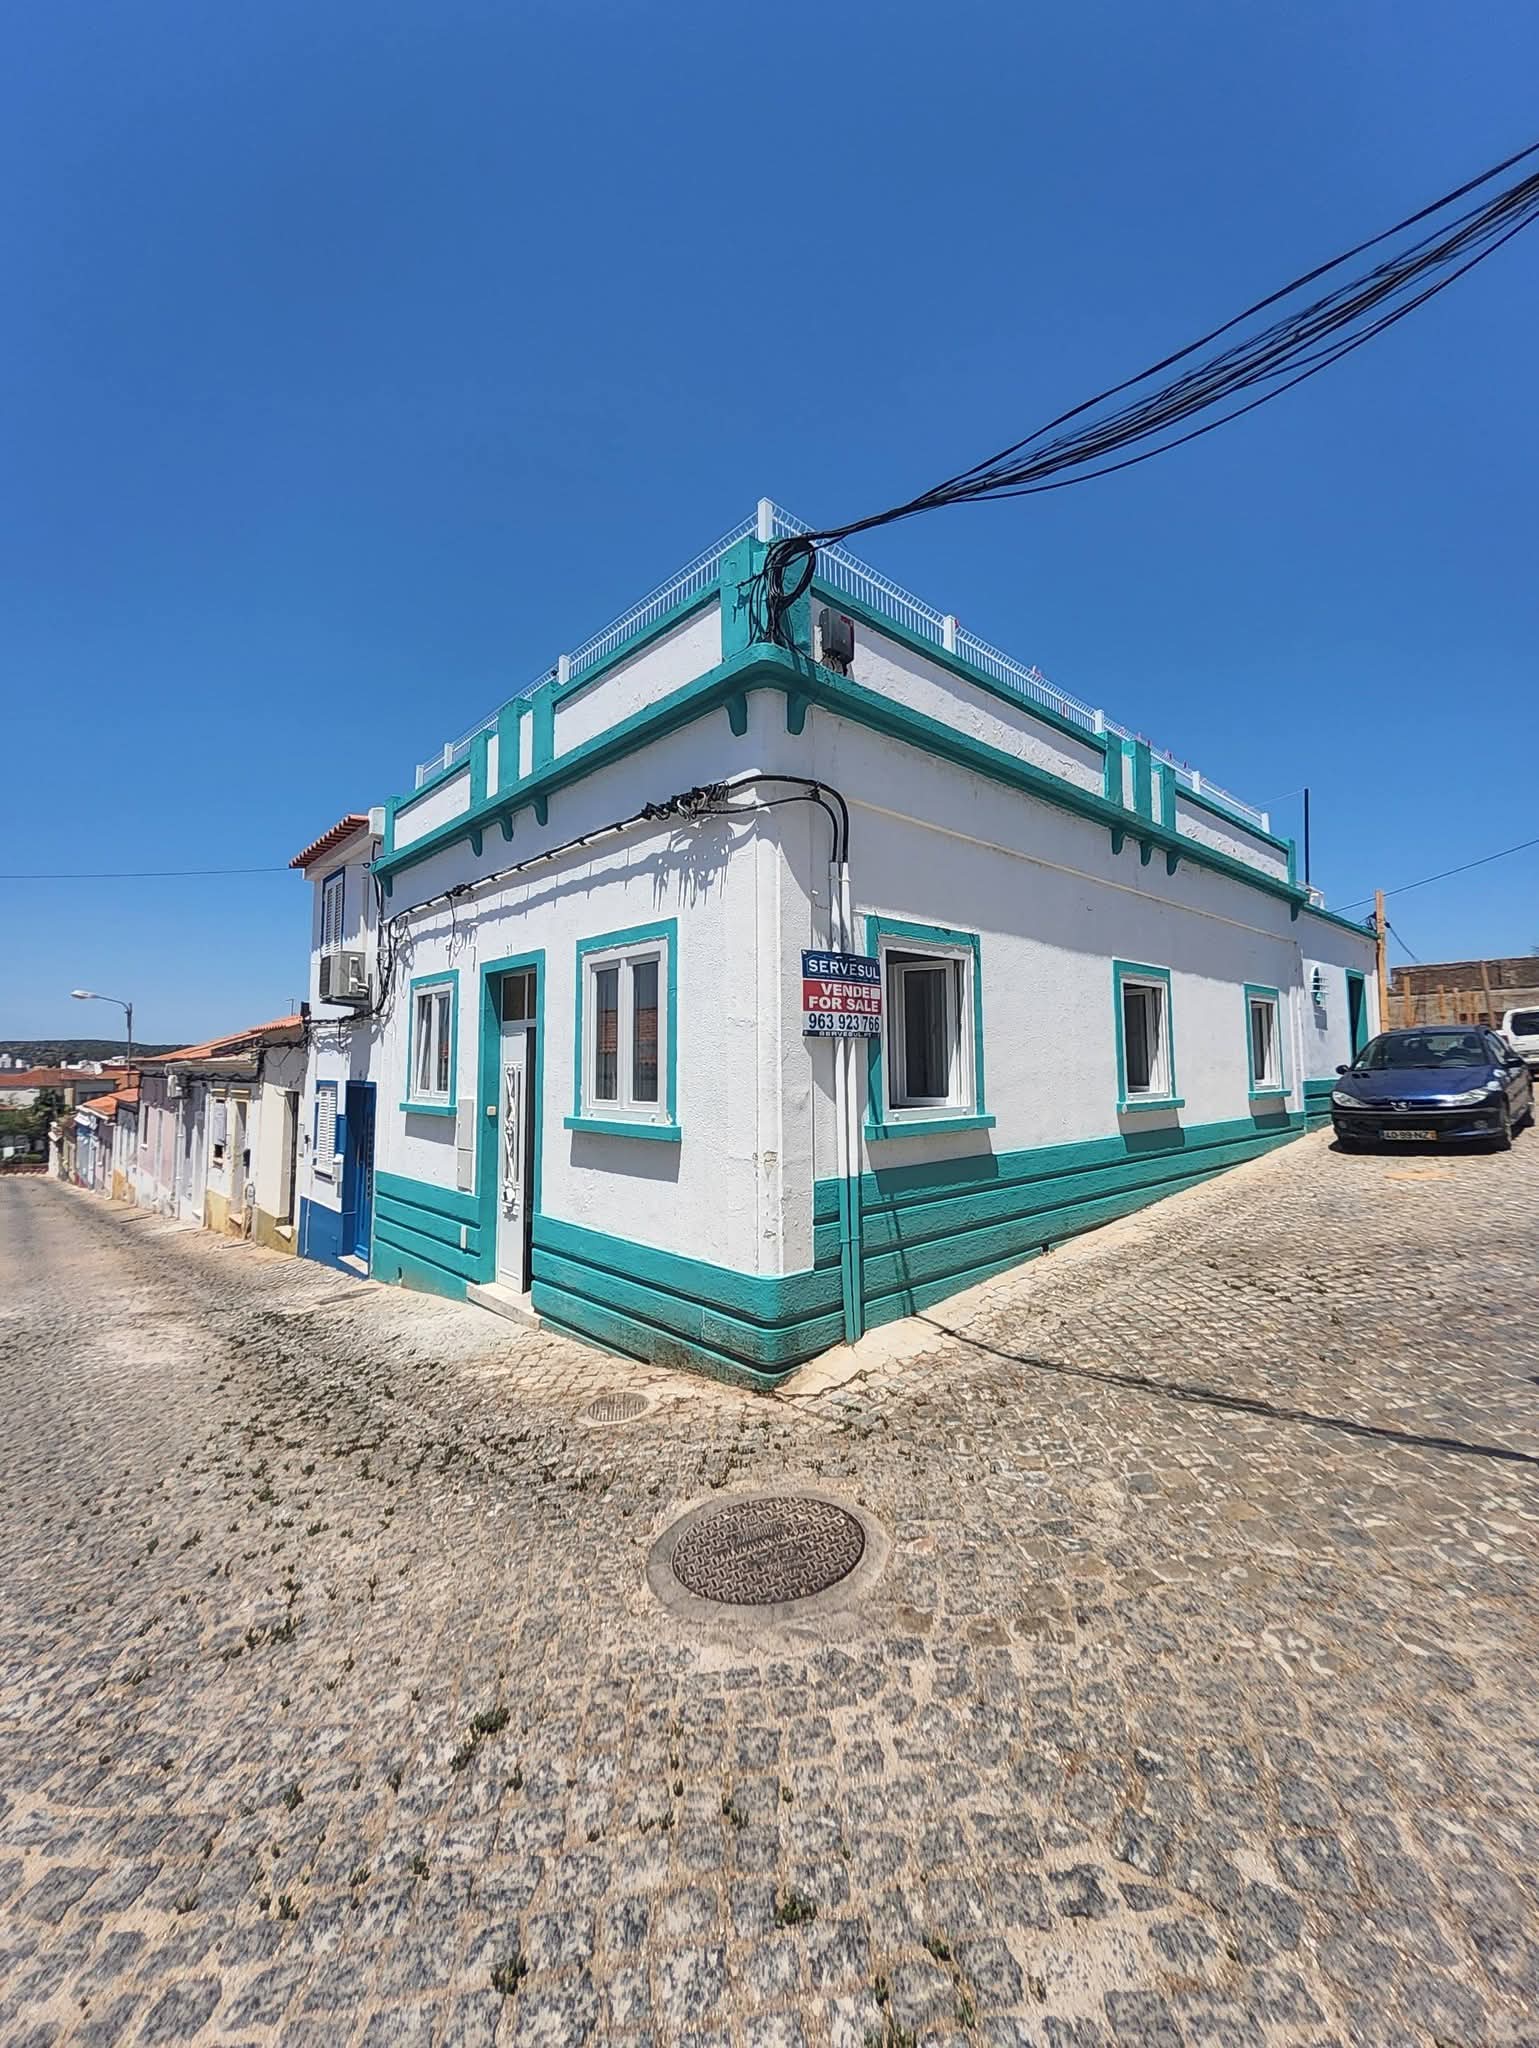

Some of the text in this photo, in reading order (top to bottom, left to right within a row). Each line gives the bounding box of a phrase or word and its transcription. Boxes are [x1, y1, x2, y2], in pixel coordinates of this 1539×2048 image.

[808, 960, 879, 979] SERVESUL
[808, 996, 879, 1012] FOR SALE
[809, 1013, 880, 1031] 963 923 766
